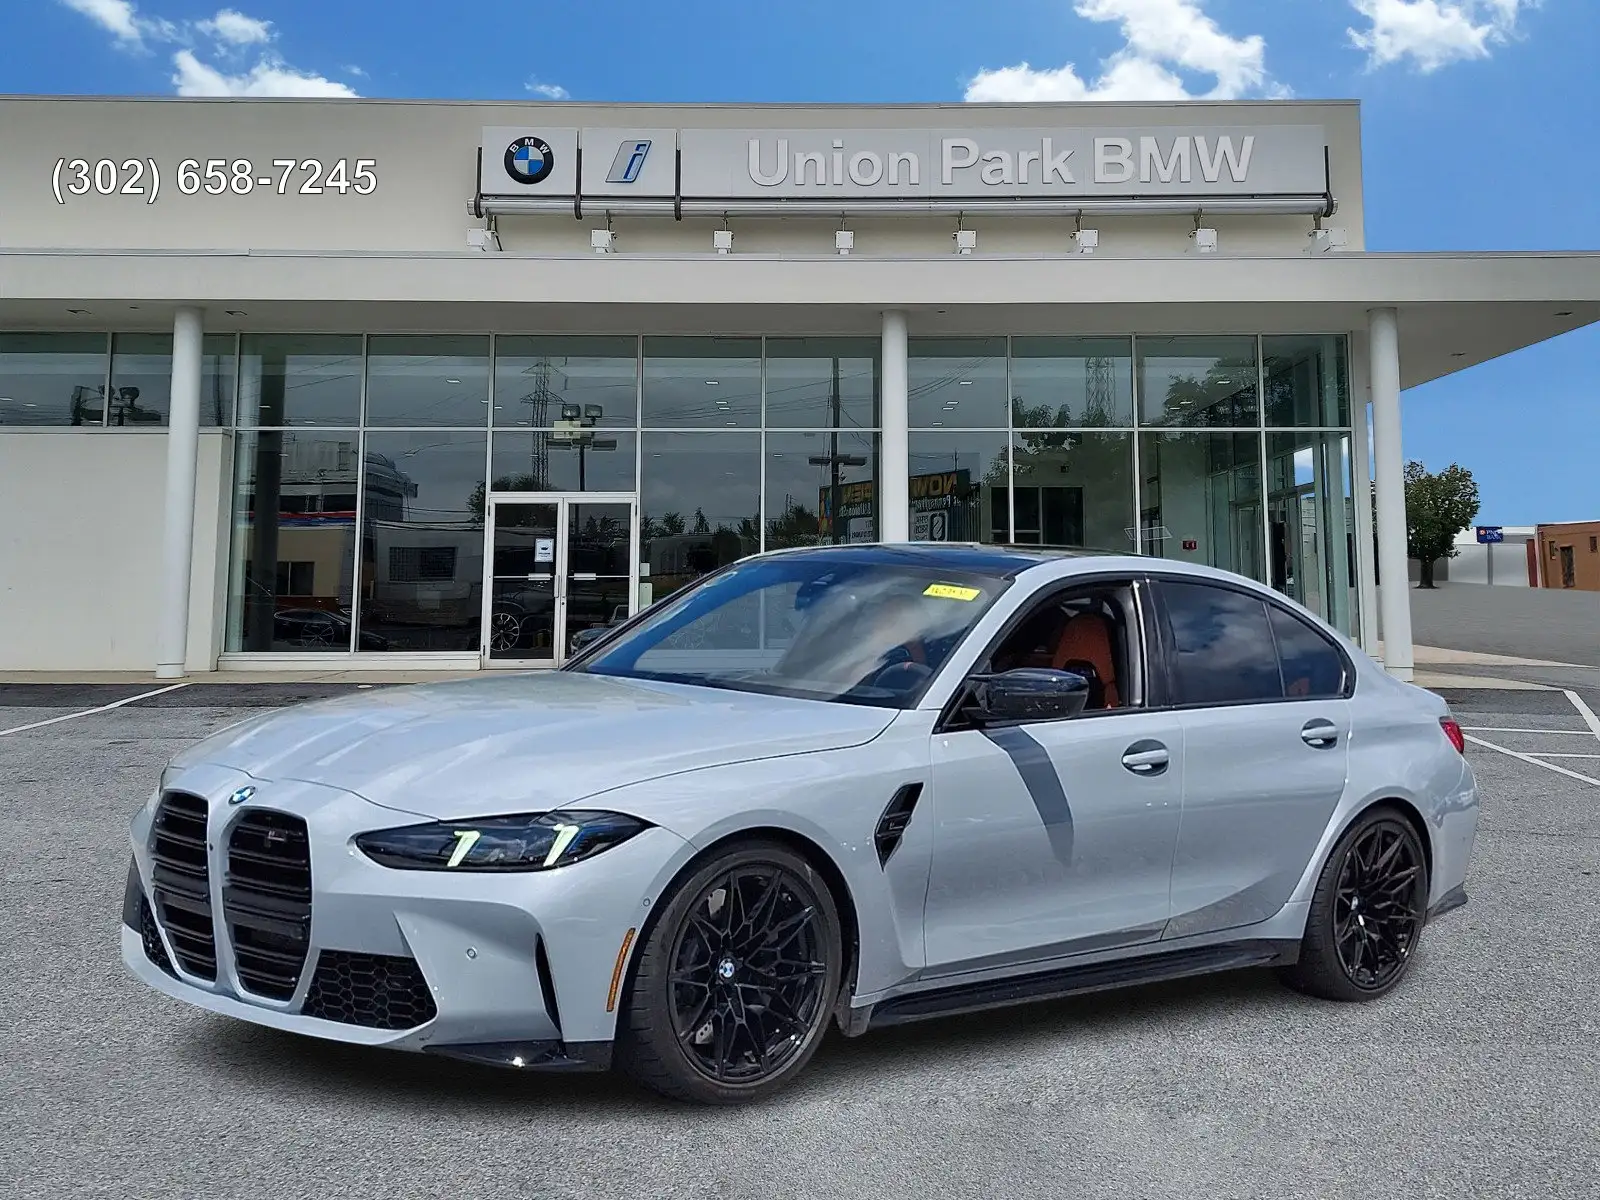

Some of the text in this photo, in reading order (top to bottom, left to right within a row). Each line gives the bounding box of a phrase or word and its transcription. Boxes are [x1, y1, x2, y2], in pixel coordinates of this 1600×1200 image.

[747, 135, 1256, 187] Union Park BMW
